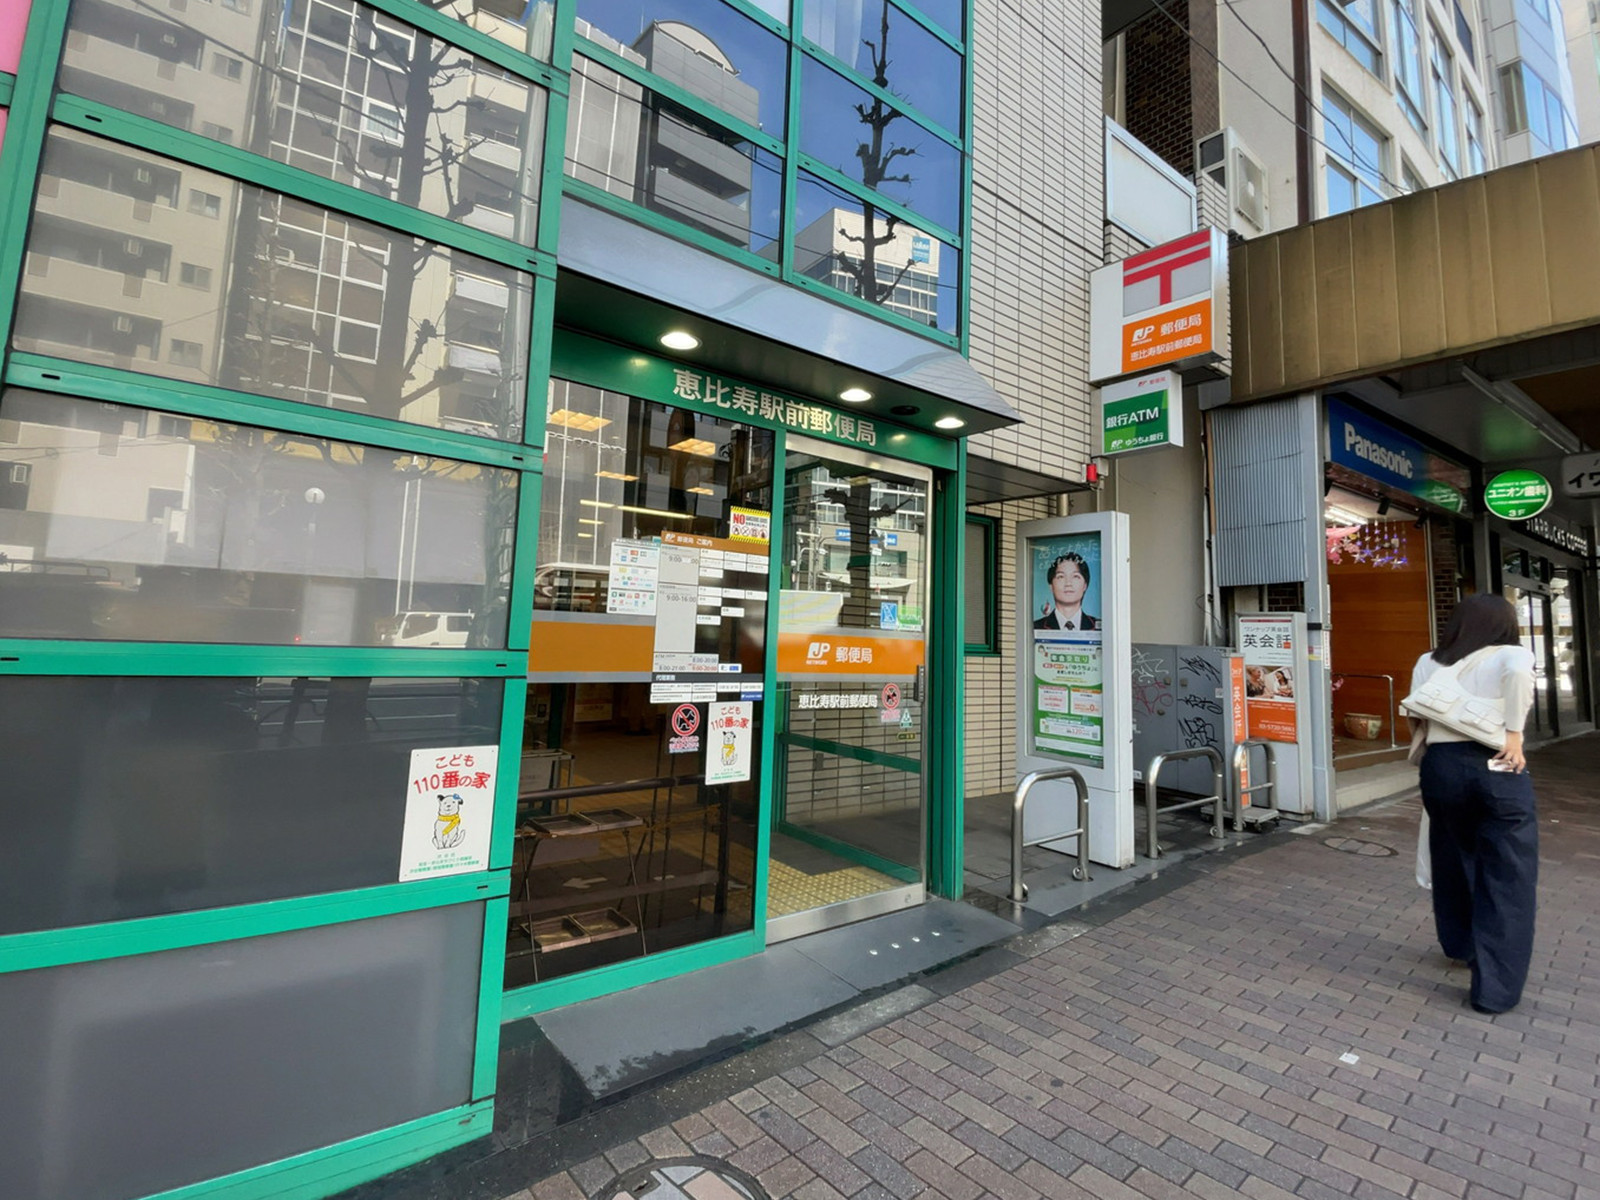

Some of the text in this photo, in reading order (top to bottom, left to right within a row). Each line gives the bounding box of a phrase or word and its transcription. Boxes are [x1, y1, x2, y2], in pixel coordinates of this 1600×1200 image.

[1160, 313, 1202, 337] 郵便局
[1131, 334, 1203, 362] 恵比寿駅前郵便局
[673, 368, 877, 446] 恵比寿駅前郵便局
[1105, 407, 1159, 429] 銀行ATM
[1125, 432, 1164, 446] ゆうちょ銀行
[1344, 422, 1413, 479] Panasonic
[1487, 484, 1547, 499] ユニオン歯科
[733, 513, 745, 525] NO
[1243, 634, 1291, 649] 英会話
[807, 642, 873, 664] JP 郵便局
[798, 694, 878, 709] 恵比寿駅前郵便局
[721, 706, 741, 715] こども
[711, 717, 750, 731] 110番の家
[435, 753, 474, 769] こども
[413, 770, 491, 794] 110番の家
